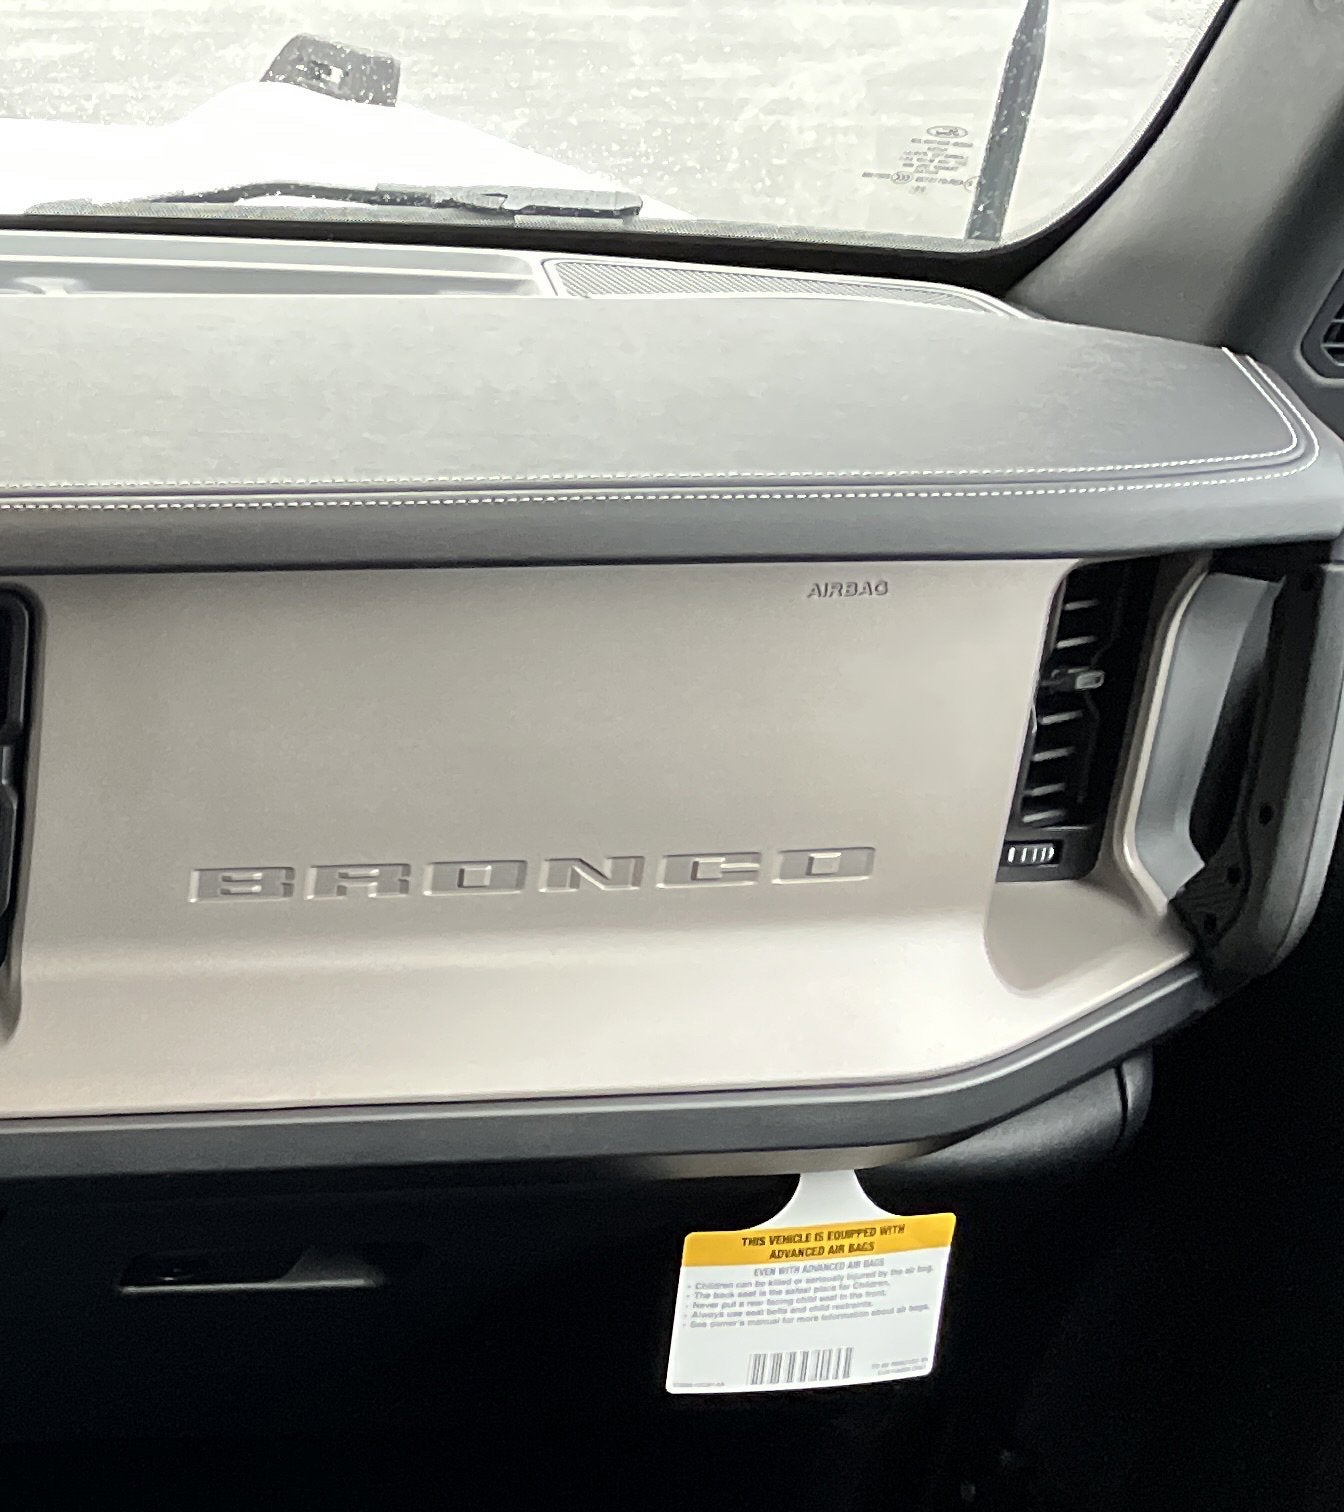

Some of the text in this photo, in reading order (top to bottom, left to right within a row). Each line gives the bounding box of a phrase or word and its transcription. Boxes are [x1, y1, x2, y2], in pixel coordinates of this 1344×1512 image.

[807, 579, 890, 599] AIRBAG
[188, 846, 877, 902] BRONCO
[741, 1223, 906, 1247] THIS VEHICLE IS EQUIPPED WITH
[768, 1241, 876, 1260] ADVANCED AIR BAGS
